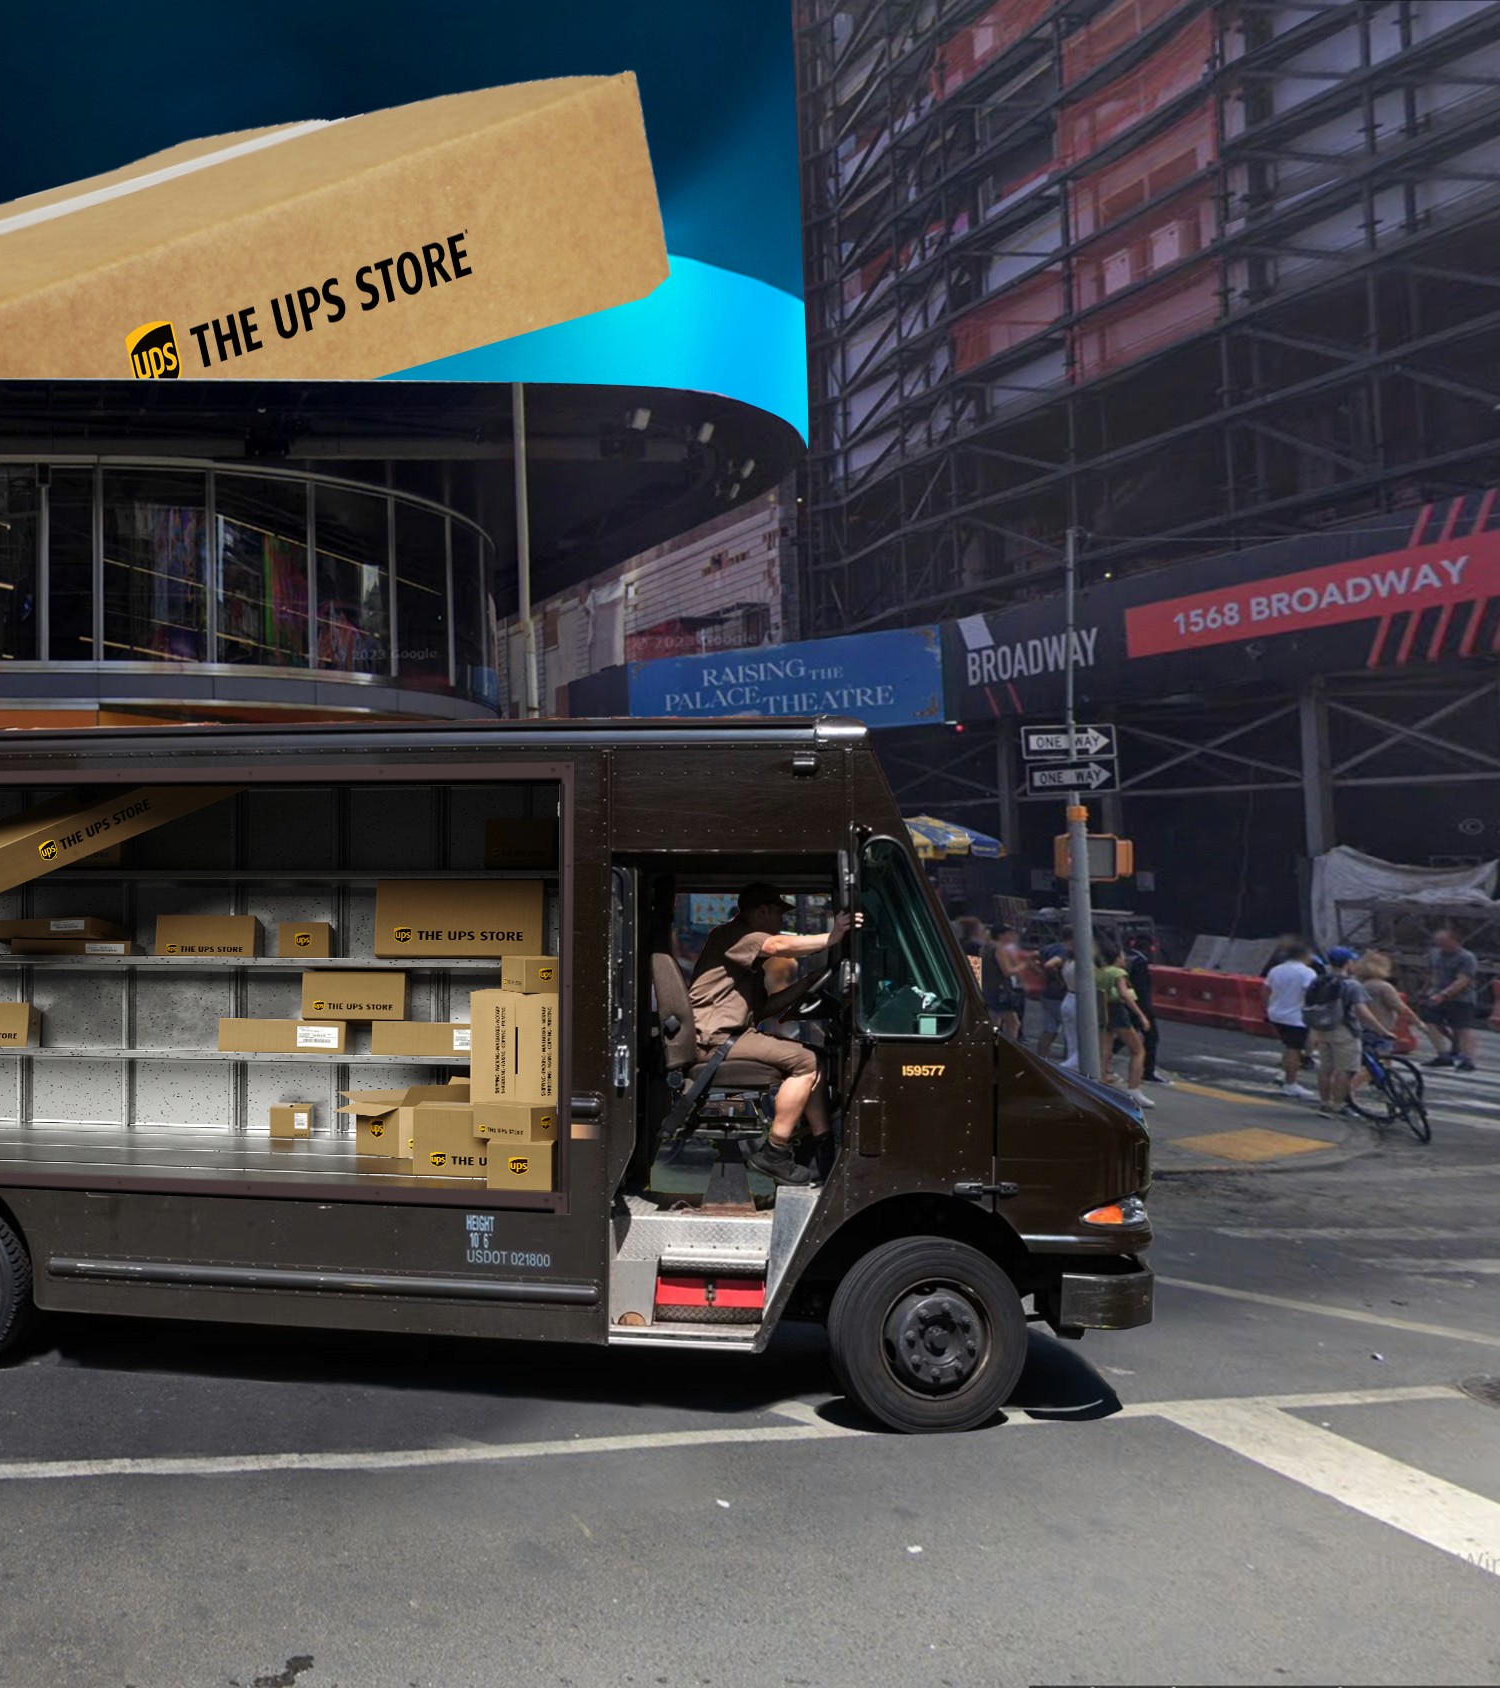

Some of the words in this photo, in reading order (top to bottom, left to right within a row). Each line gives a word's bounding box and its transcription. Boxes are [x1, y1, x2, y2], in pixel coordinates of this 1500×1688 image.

[190, 306, 263, 368] THE
[271, 277, 346, 340] UPS
[355, 232, 473, 312] STORE
[1173, 602, 1241, 636] 1568
[1250, 555, 1471, 623] BROADWAY
[966, 626, 1099, 686] BROADWAY
[702, 658, 805, 687] RAISING
[808, 665, 844, 681] THE
[665, 685, 761, 711] PALACE
[763, 684, 896, 714] THEATRE
[1036, 737, 1062, 748] ONE
[1074, 736, 1100, 747] WAY
[1039, 773, 1065, 784] ONE
[1074, 770, 1101, 782] WAY
[59, 830, 83, 850] THE
[86, 818, 110, 839] UPS
[112, 799, 152, 826] STORE
[417, 930, 443, 941] THE
[448, 931, 475, 941] UPS
[480, 931, 524, 942] STORE
[180, 945, 196, 953] THE
[198, 945, 215, 953] UPS
[217, 945, 244, 953] STORE
[327, 1002, 343, 1011] THE
[346, 1003, 364, 1011] UPS
[366, 1003, 393, 1011] STORE
[451, 1155, 474, 1166] THE
[466, 1214, 495, 1232] HEIGHT
[466, 1249, 508, 1265] USDOT
[510, 1252, 551, 1268] 021800
